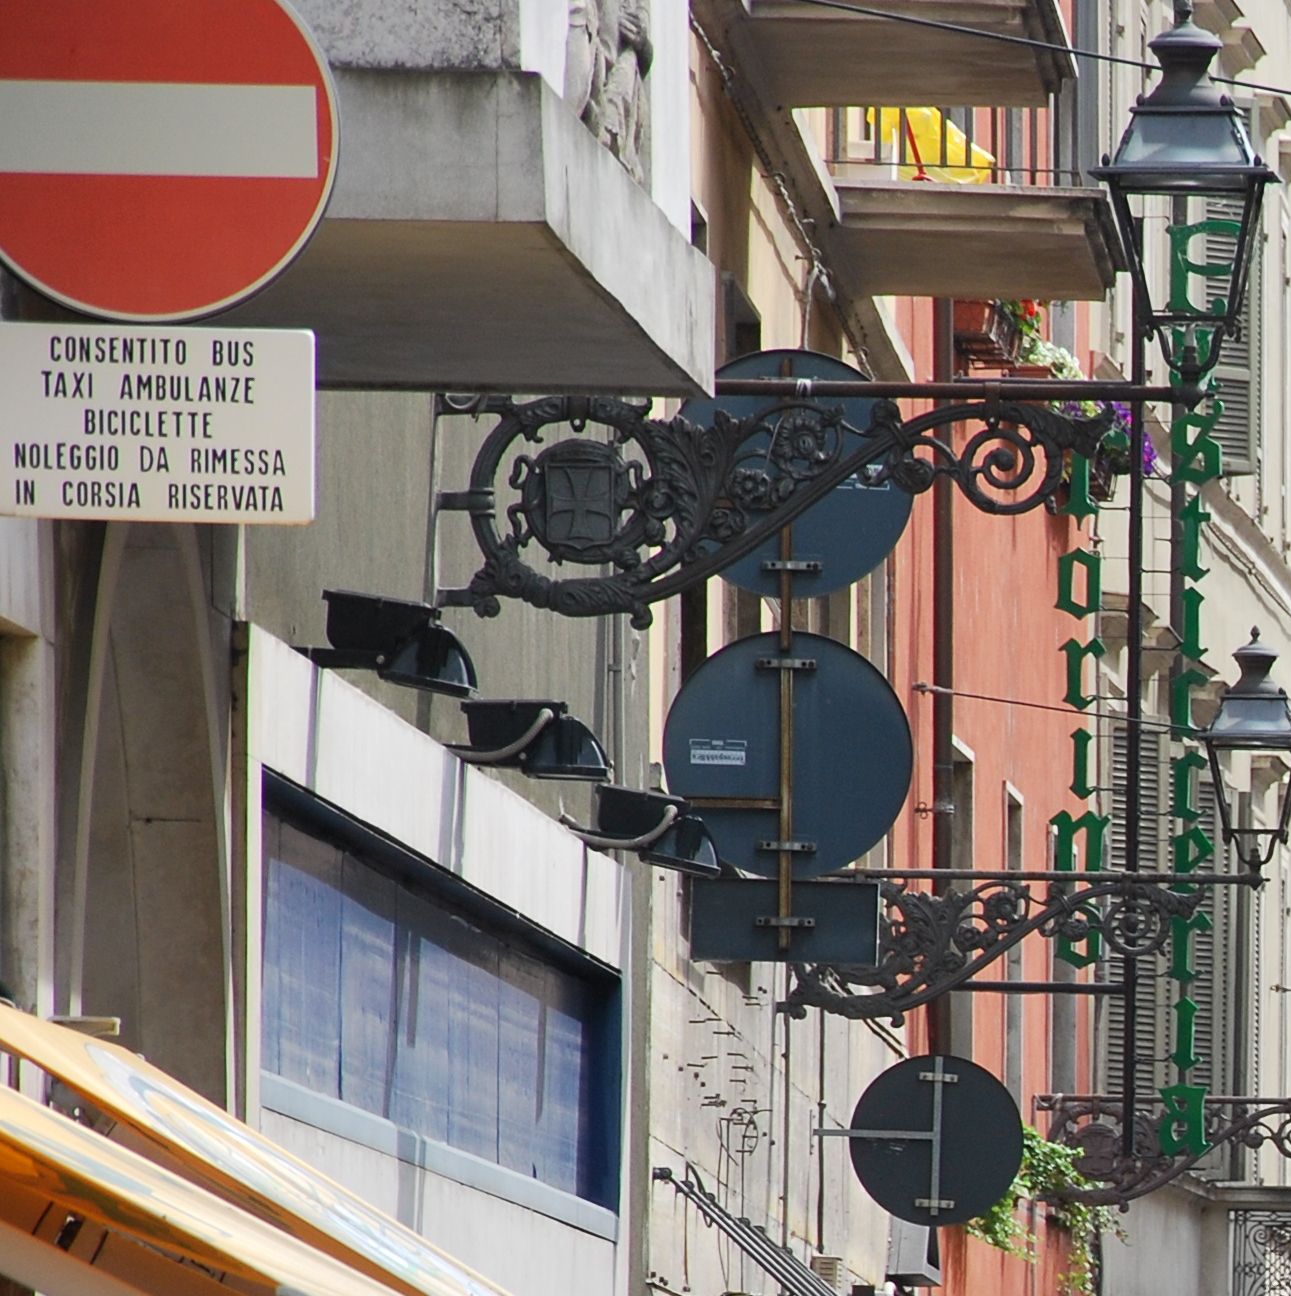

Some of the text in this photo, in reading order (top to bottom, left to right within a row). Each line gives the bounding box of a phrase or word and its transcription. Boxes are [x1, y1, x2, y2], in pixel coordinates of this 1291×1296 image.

[49, 336, 256, 368] CONSENTITO BUS
[40, 370, 256, 405] TAXI AMBULANZE
[83, 408, 214, 439] BICICLETTE
[13, 442, 287, 477] NOLEGGIO DA RIMESSA
[14, 479, 285, 513] IN CORSIA RISERVATA
